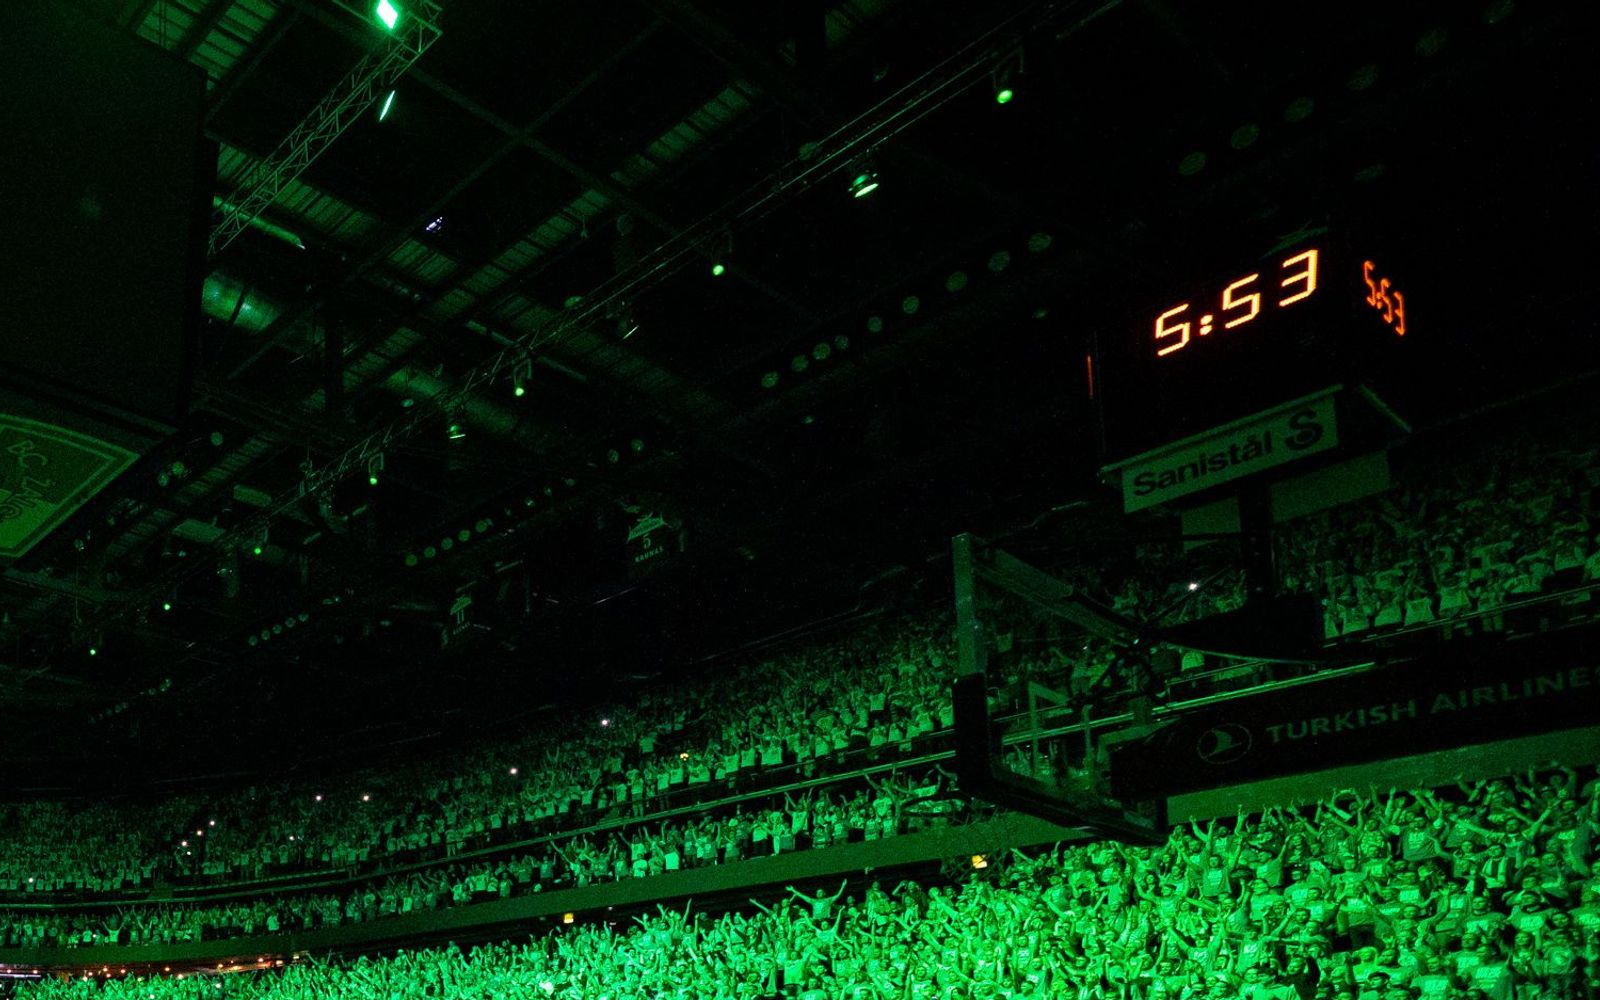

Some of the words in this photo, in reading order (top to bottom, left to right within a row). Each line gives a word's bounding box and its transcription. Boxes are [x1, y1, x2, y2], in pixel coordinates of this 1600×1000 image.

[1155, 249, 1319, 357] 5:53
[1363, 260, 1406, 336] 5:53
[5, 439, 49, 469] BC
[1265, 699, 1418, 744] TURKISH
